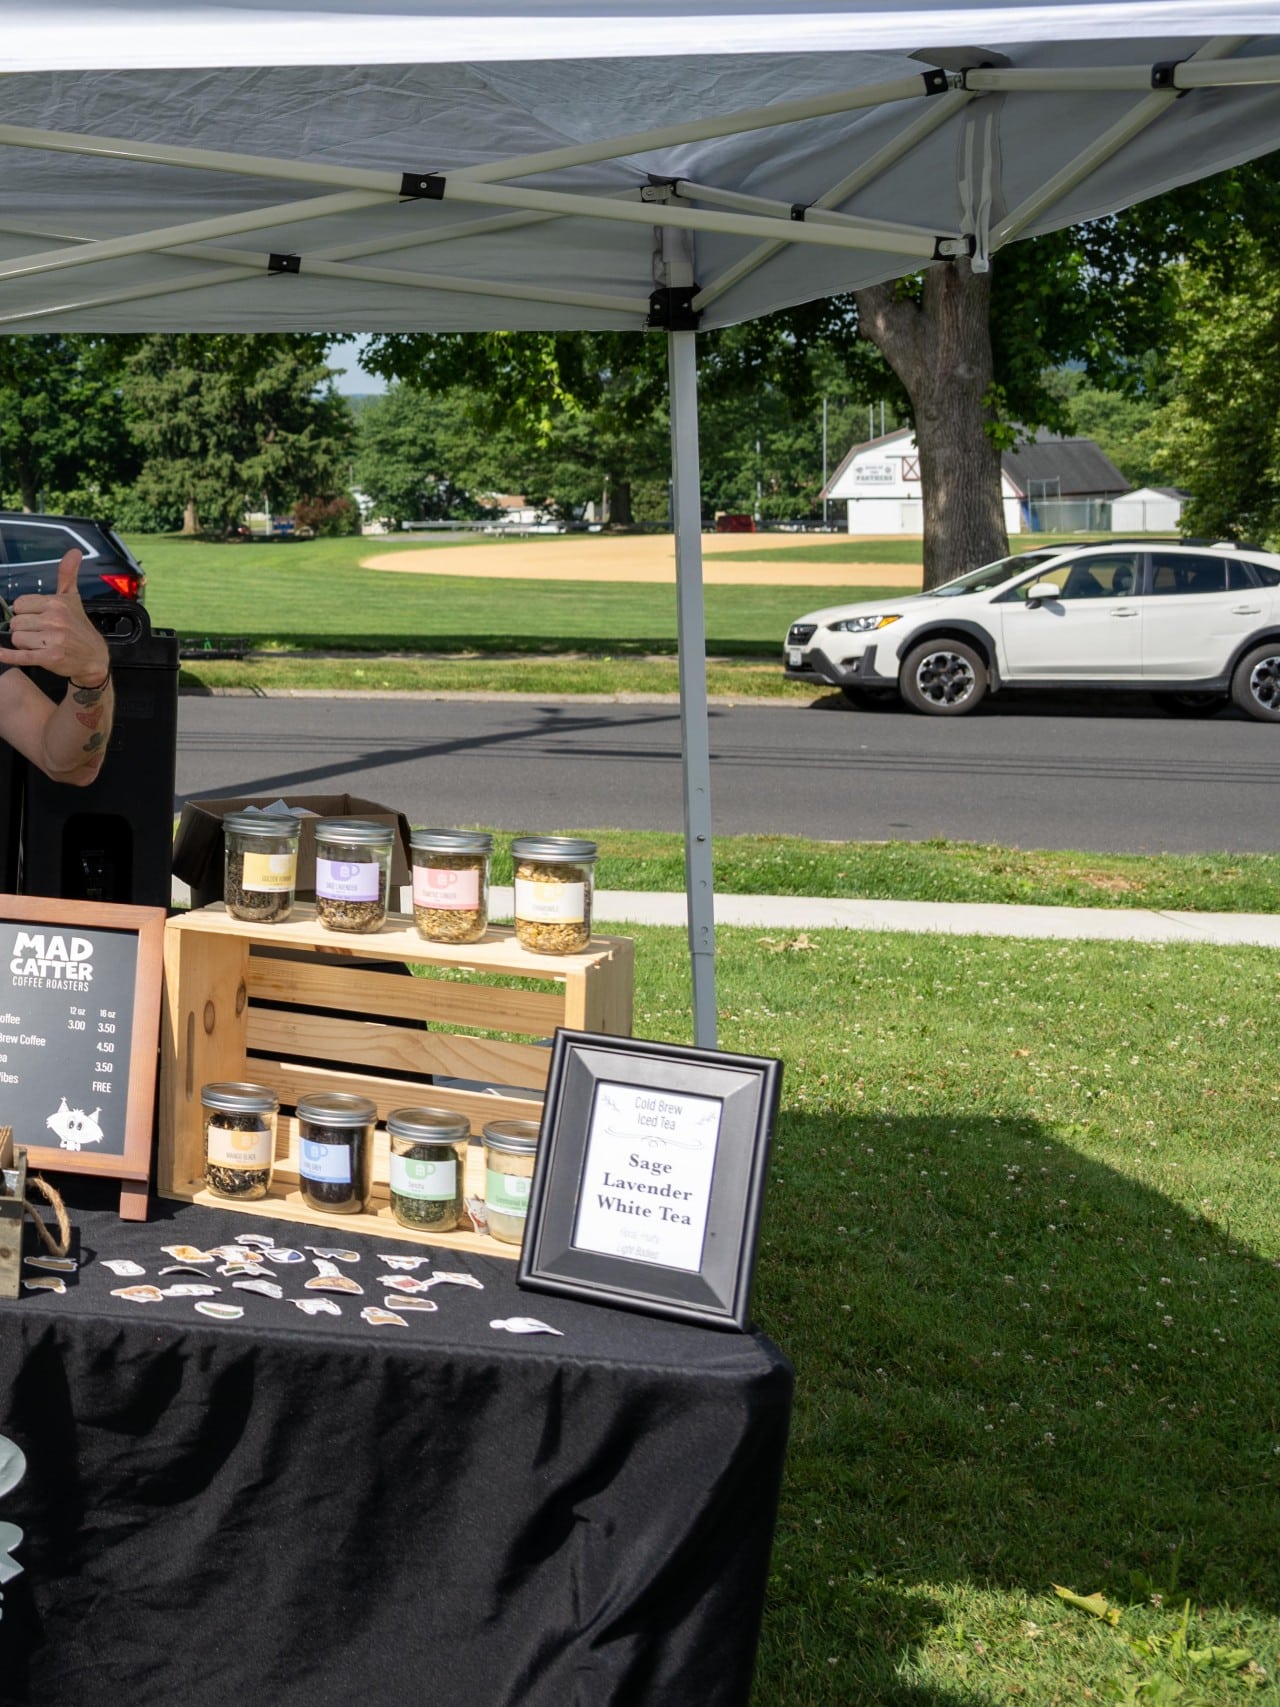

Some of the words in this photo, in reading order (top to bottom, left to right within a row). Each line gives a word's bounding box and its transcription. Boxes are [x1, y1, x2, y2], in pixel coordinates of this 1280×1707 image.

[13, 932, 94, 961] MAD
[10, 958, 94, 981] CATTER
[12, 976, 43, 989] COFFEE
[46, 977, 89, 992] ROASTERS
[70, 1006, 77, 1015] 12
[78, 1008, 86, 1016] oz
[100, 1009, 107, 1018] 16
[108, 1011, 116, 1019] oz
[67, 1020, 86, 1031] 3.00
[97, 1022, 116, 1034] 3.50
[20, 1033, 47, 1047] Coffee
[96, 1042, 115, 1053] 4.50
[94, 1061, 113, 1073] 3.50
[92, 1081, 112, 1093] FREE
[634, 1096, 656, 1112] Cold
[658, 1099, 683, 1116] Brew
[637, 1112, 658, 1128] Iced
[659, 1115, 676, 1131] Tea
[628, 1153, 673, 1175] Sage
[602, 1172, 693, 1201] Lavender
[597, 1194, 652, 1218] White
[659, 1206, 692, 1226] Tea
